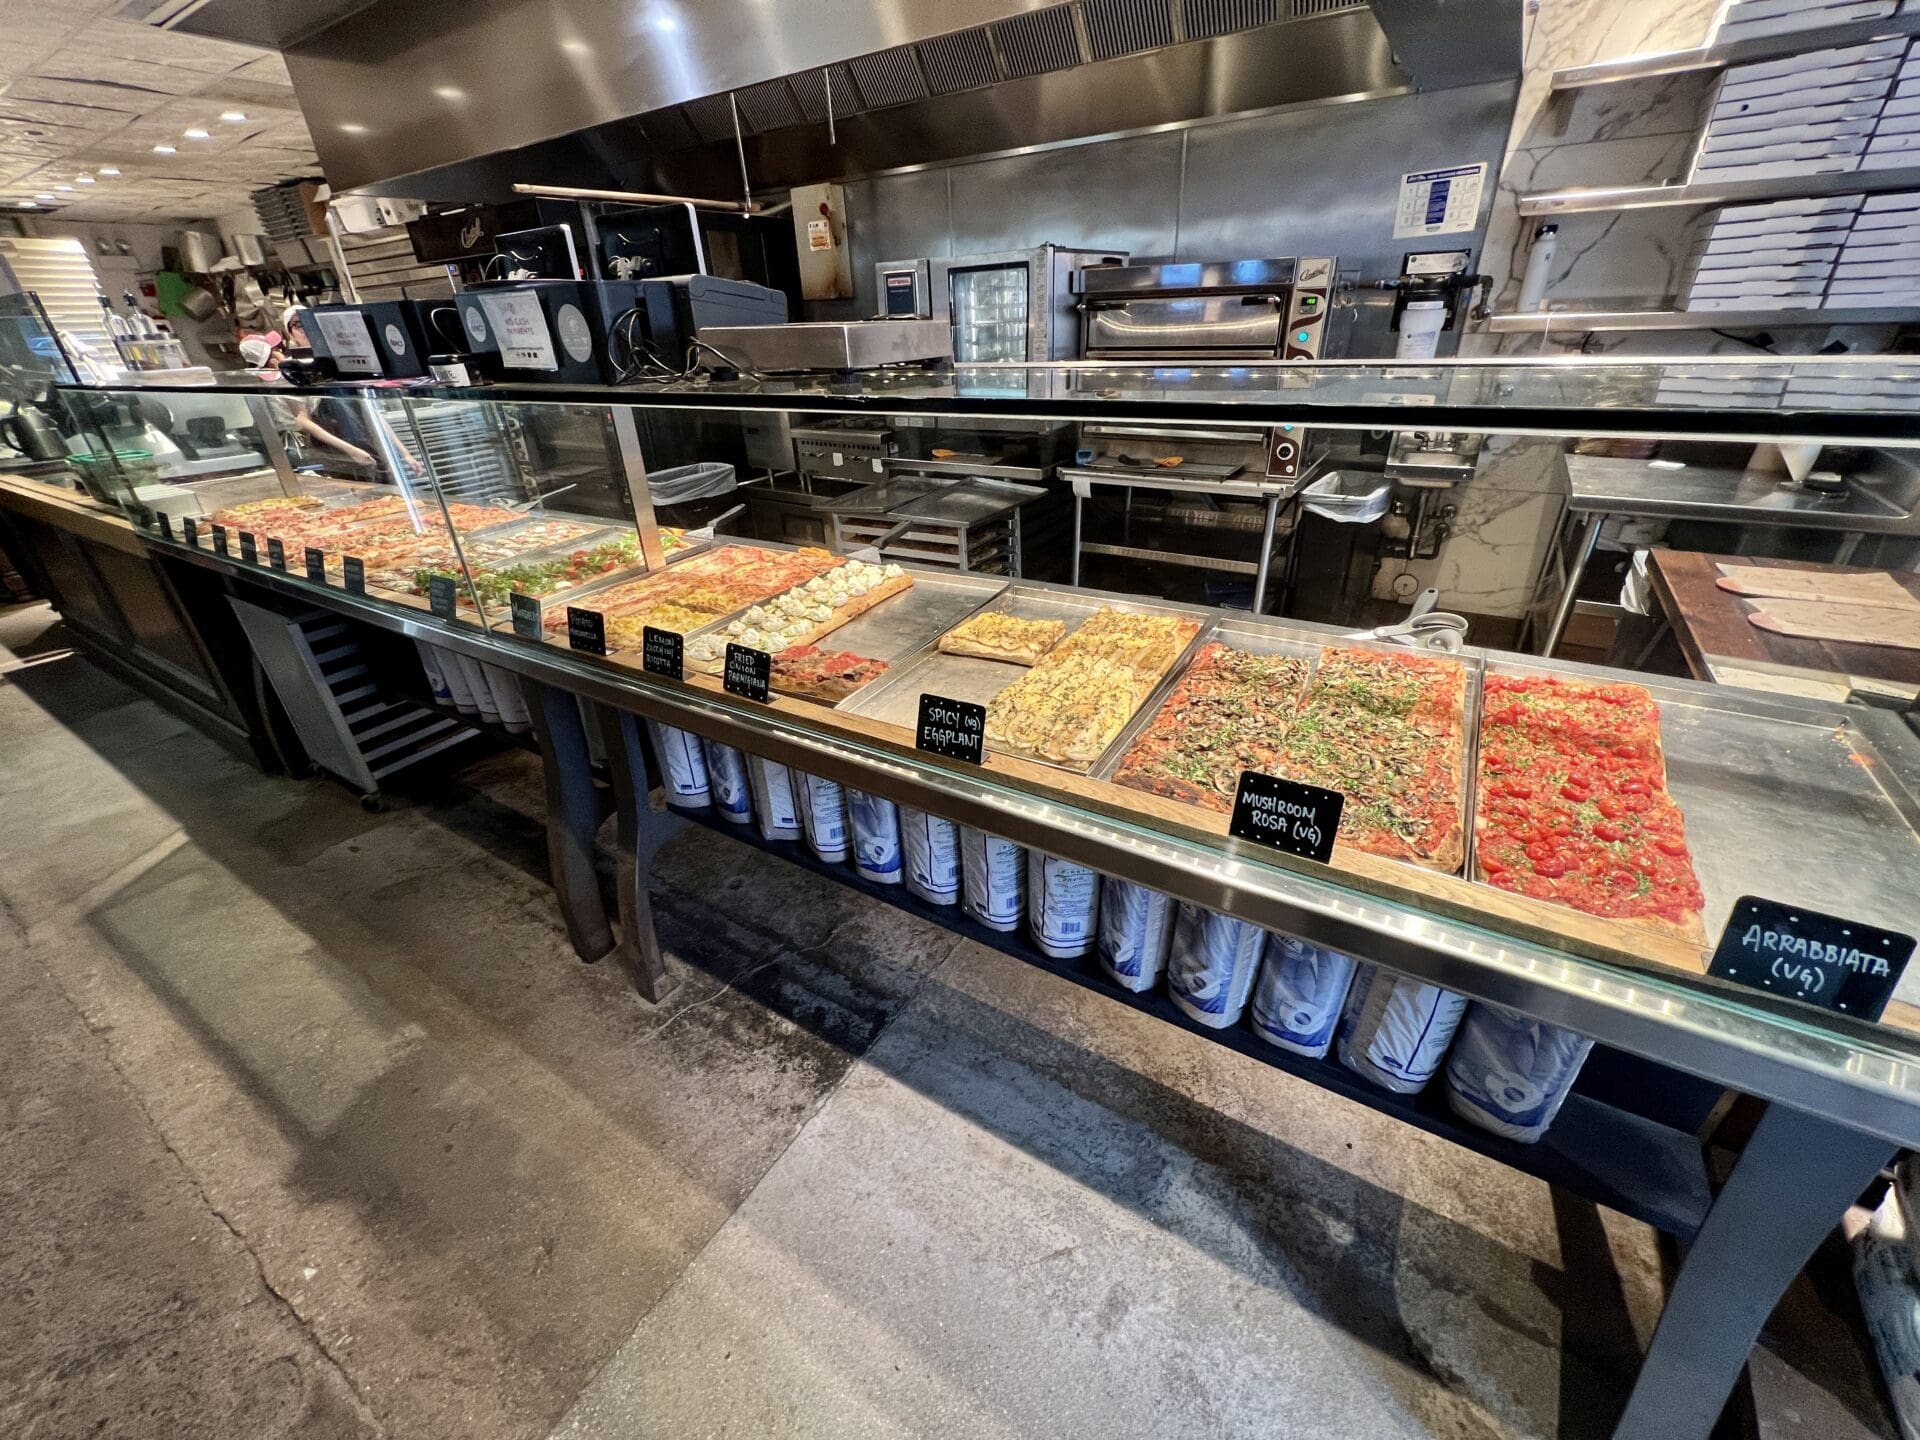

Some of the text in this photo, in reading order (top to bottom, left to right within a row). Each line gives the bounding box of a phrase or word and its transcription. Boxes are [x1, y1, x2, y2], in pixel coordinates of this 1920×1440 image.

[648, 633, 675, 647] LEMON
[729, 661, 756, 676] ONION
[733, 652, 755, 666] FRIED
[928, 707, 960, 729] SPICY
[924, 726, 980, 750] EGGPLANT
[1242, 791, 1316, 826] MUSHROOM
[1251, 810, 1288, 832] ROSA
[1742, 924, 1890, 977] ARRABBIATA
